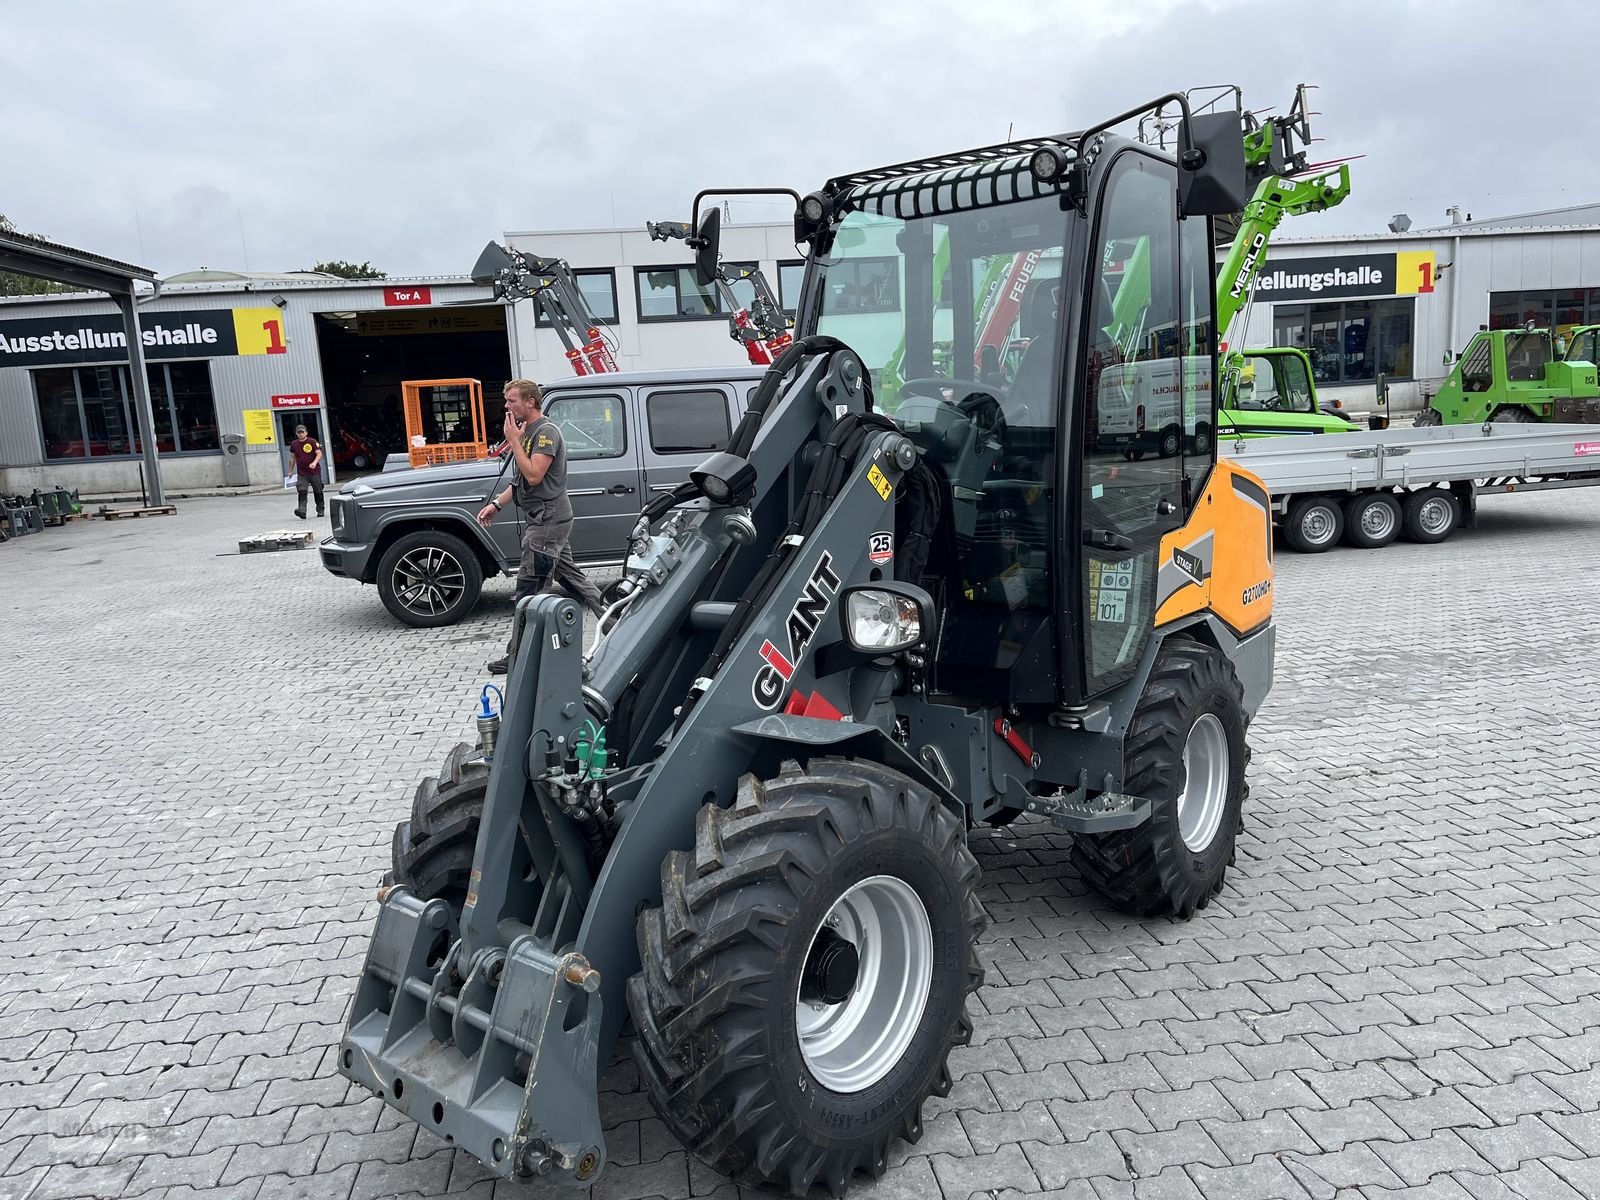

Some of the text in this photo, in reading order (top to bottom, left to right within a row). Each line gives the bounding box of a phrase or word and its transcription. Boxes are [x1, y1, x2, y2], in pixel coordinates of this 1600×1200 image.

[1009, 249, 1041, 302] FEUER
[1230, 233, 1266, 298] MERLO
[1246, 262, 1434, 293] tellungshalle 1
[394, 291, 421, 300] Tor A
[0, 320, 287, 354] Ausstellunshalle 1
[278, 397, 306, 405] Eingang
[873, 536, 890, 552] 25
[1177, 555, 1201, 575] STAGE V
[1100, 604, 1116, 620] 101
[752, 550, 841, 710] GIANT
